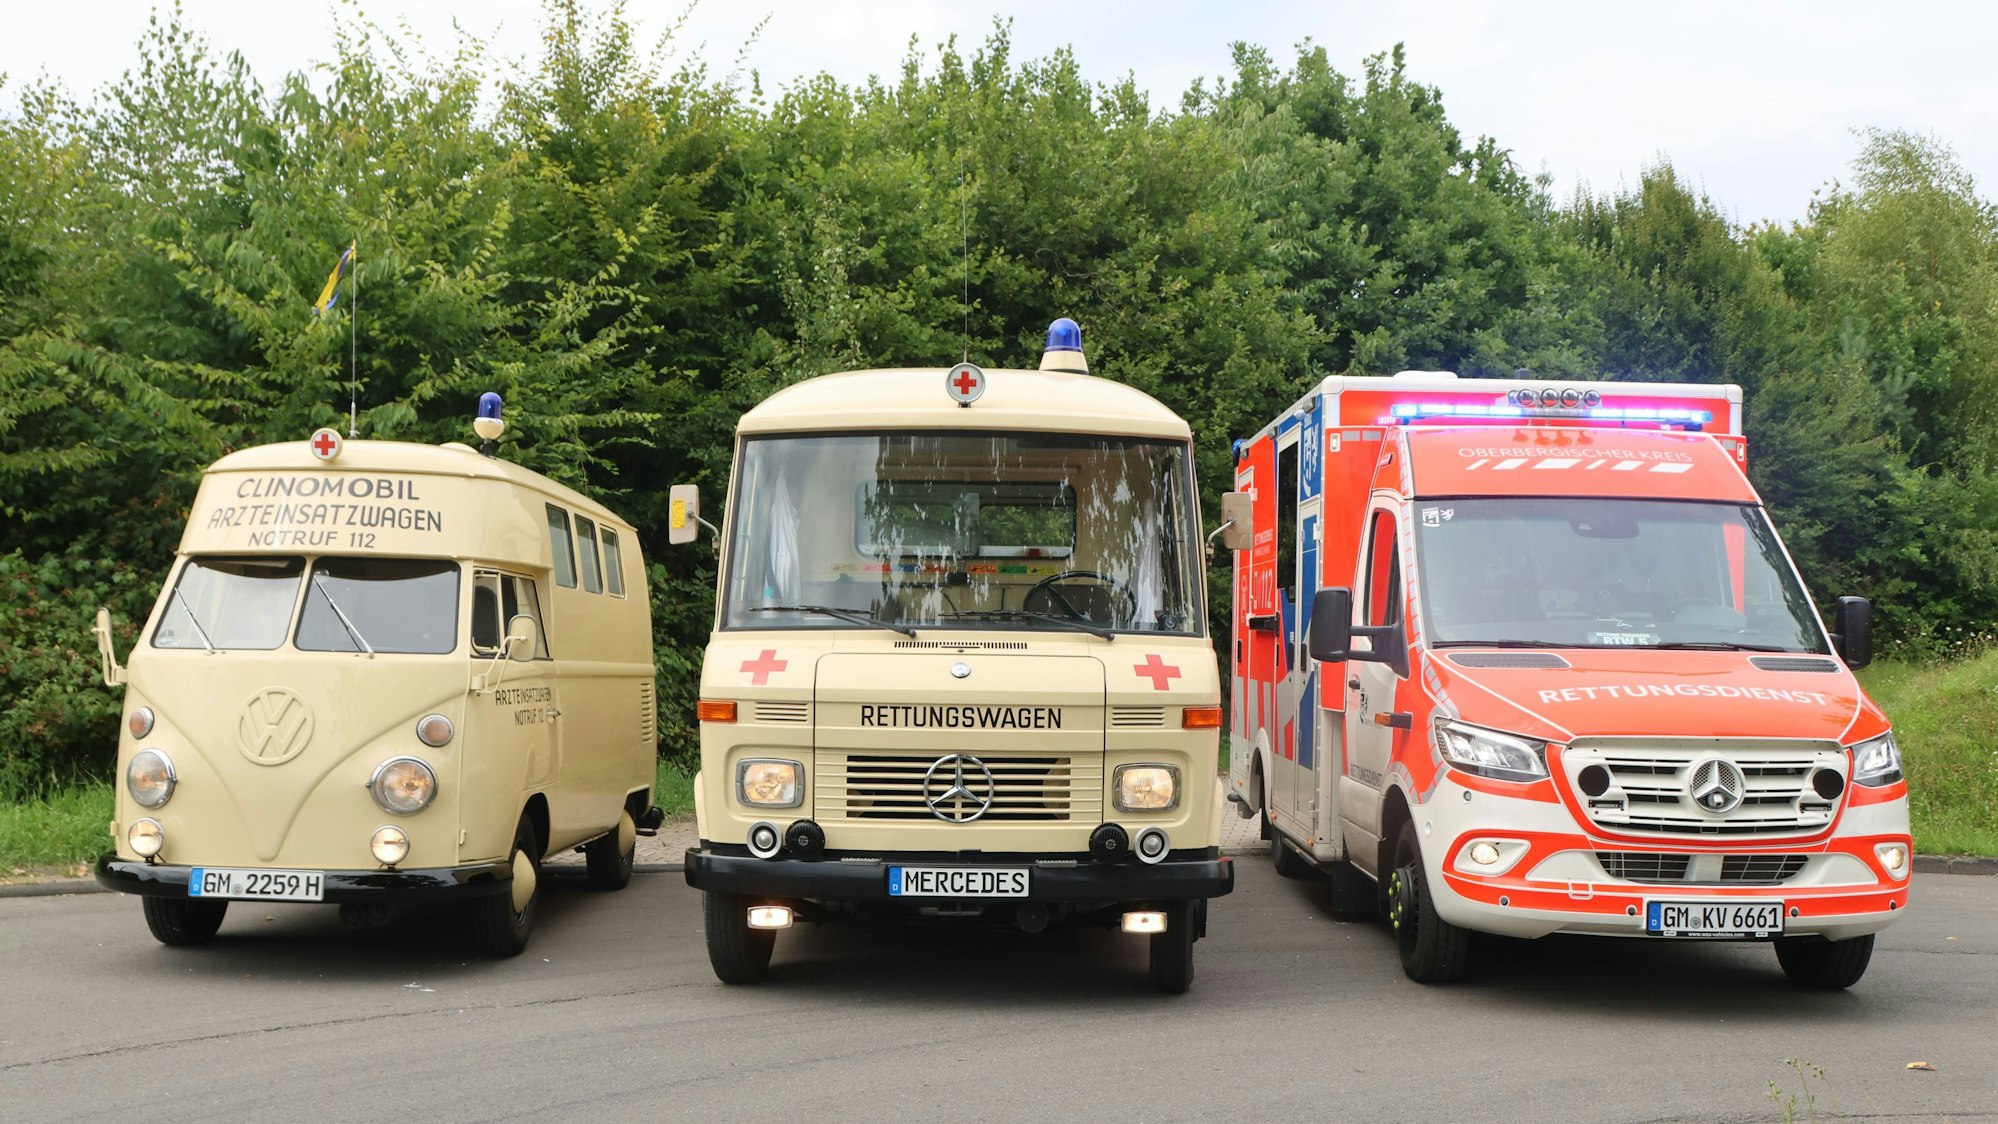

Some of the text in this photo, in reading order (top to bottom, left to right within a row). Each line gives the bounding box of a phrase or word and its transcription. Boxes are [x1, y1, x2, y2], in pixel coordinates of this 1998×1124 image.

[1458, 447, 1693, 463] OBERBERGISCHER KREIS
[236, 476, 420, 501] CLINOMOBIL
[207, 503, 442, 533] ARZTEINSATZWAGEN
[248, 530, 376, 548] NOTRUF 112
[1261, 567, 1273, 609] 112
[1602, 636, 1635, 645] RTW
[1538, 684, 1827, 706] RETTUNGSDIENST
[861, 705, 1062, 729] RETTUNGSWAGEN
[203, 872, 231, 894] GM
[245, 873, 300, 896] 2259
[305, 876, 320, 896] H
[905, 871, 1025, 894] MERCEDES
[1663, 907, 1689, 928] GM
[1702, 907, 1728, 928] KV
[1733, 907, 1779, 929] 6661
